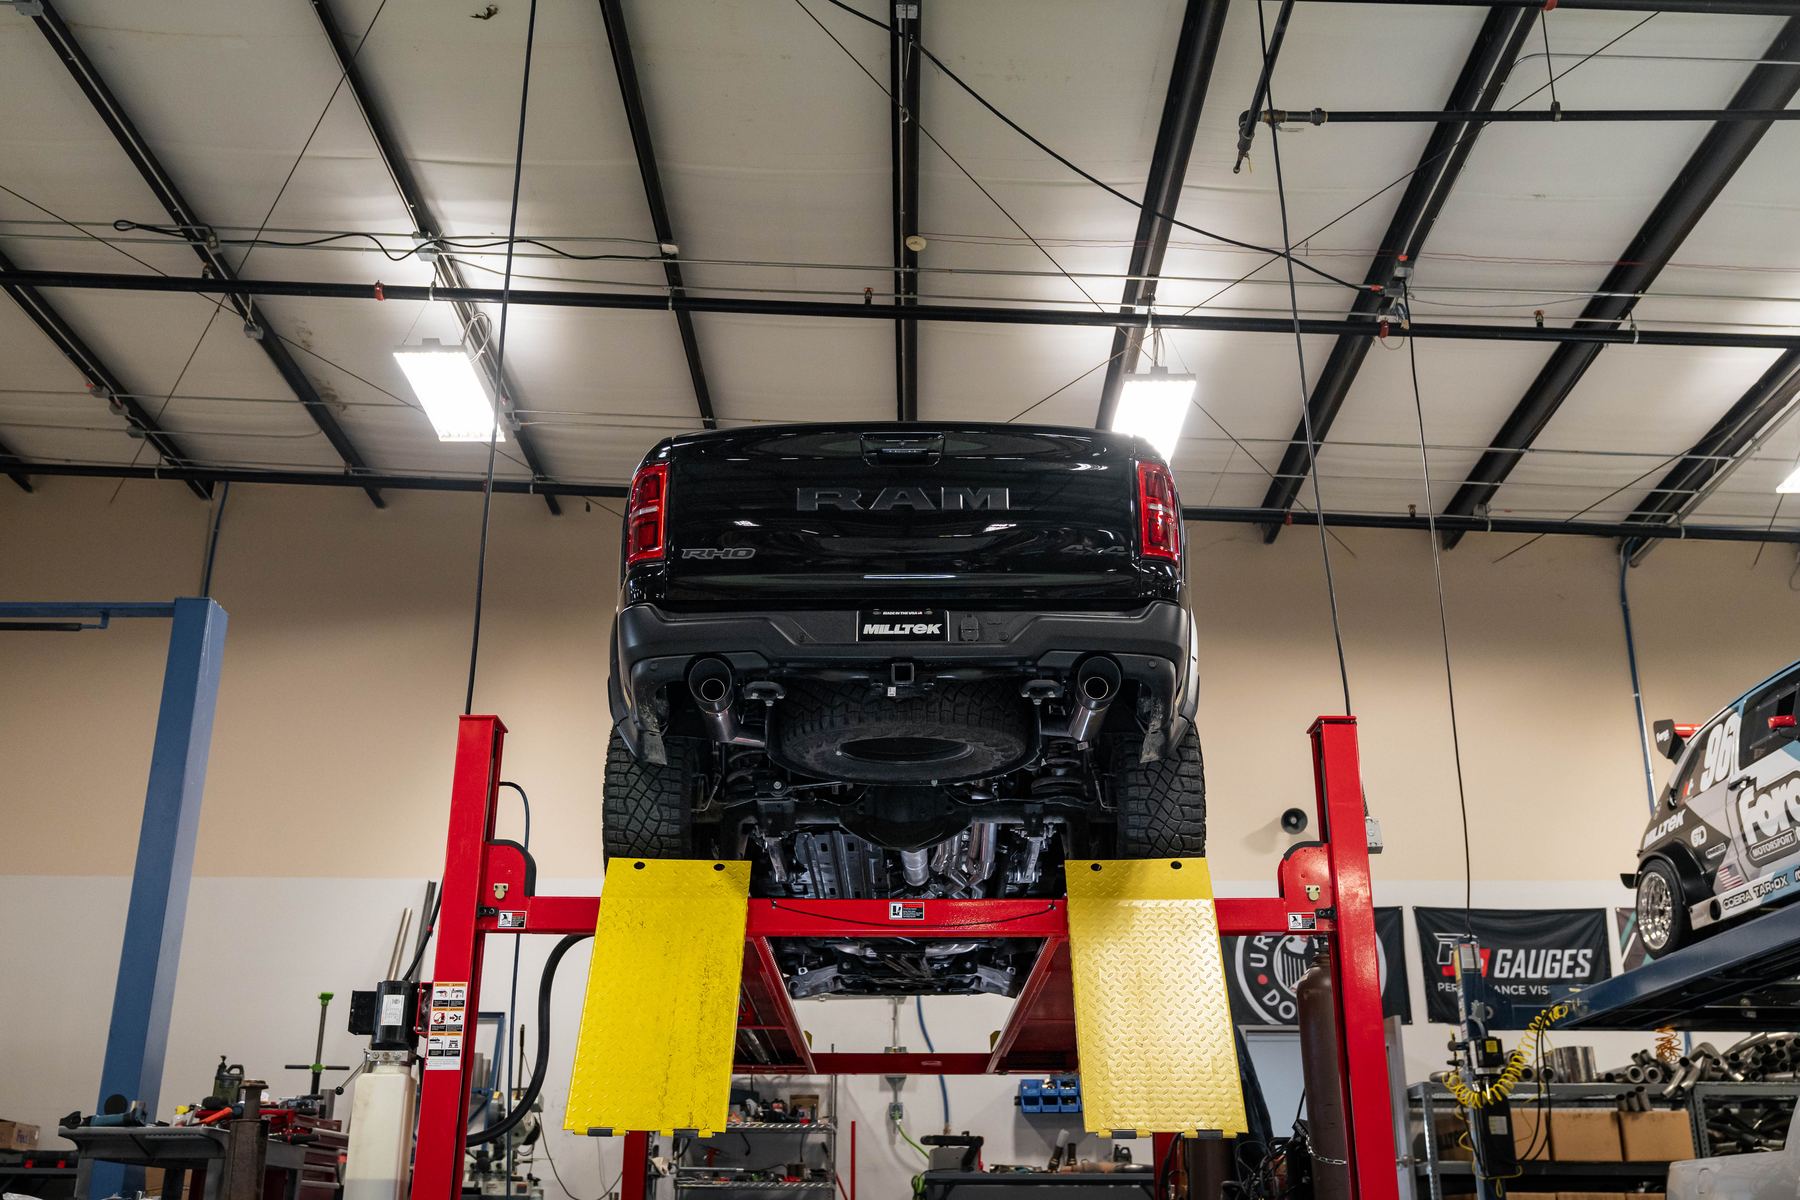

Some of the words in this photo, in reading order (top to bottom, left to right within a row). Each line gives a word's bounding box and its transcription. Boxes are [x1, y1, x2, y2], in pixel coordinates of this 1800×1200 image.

[797, 487, 1009, 511] RAM
[681, 548, 756, 560] RHO
[1751, 832, 1794, 857] MOTORSPORT
[1723, 891, 1752, 910] COBRA
[1494, 949, 1593, 979] GAUGES
